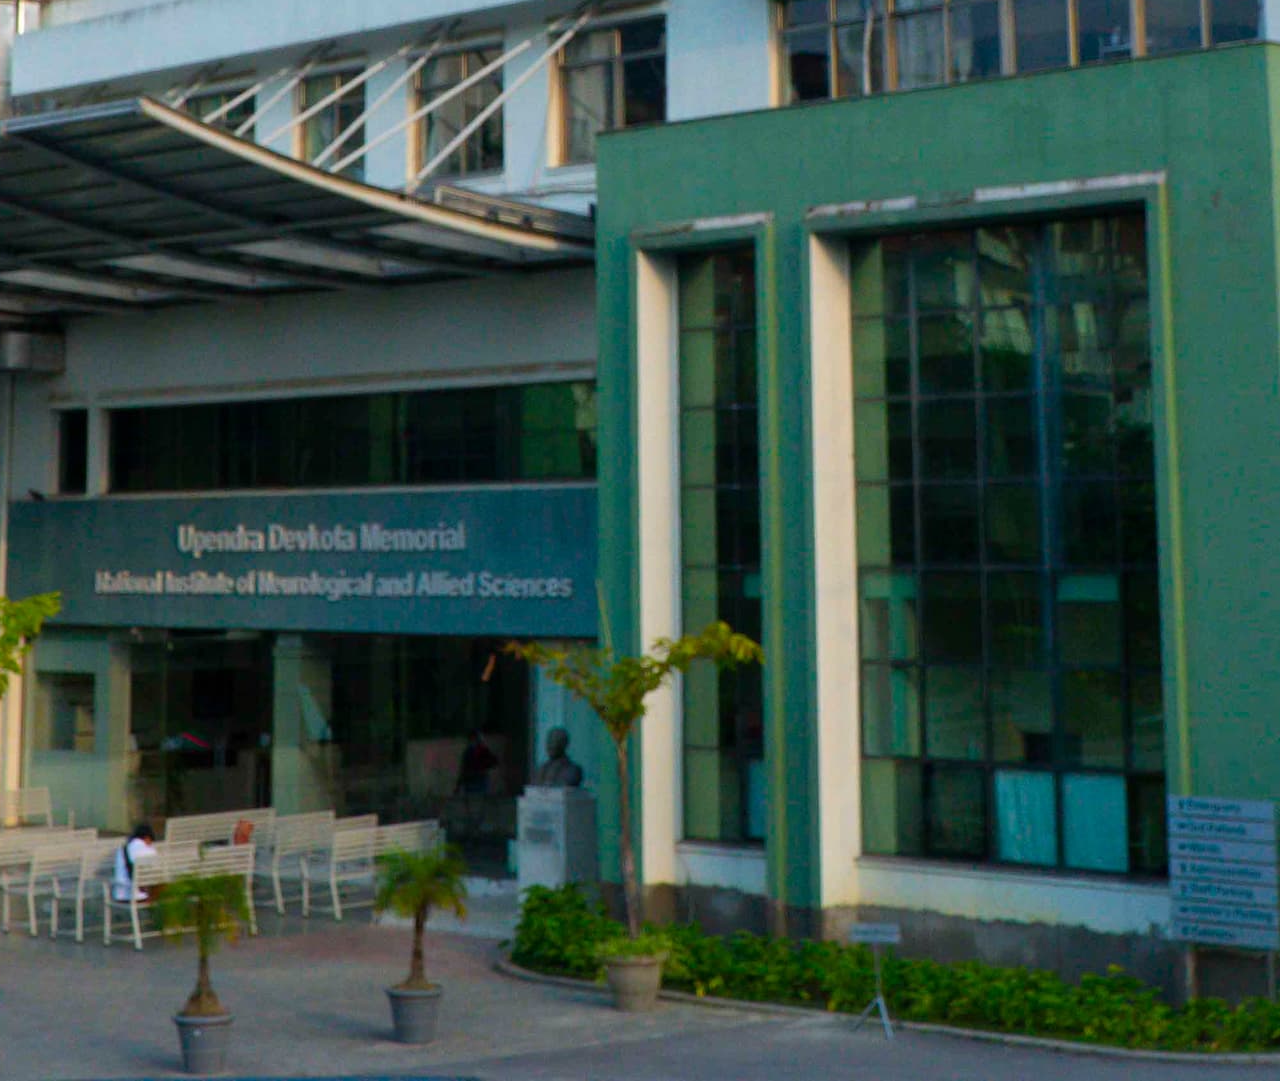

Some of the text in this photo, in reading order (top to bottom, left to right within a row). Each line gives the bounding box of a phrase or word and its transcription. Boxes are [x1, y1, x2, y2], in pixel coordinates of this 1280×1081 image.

[178, 522, 466, 558] Upendra Devkota Memorial
[95, 570, 573, 601] National Institute of Neurological and Allied Sciences
